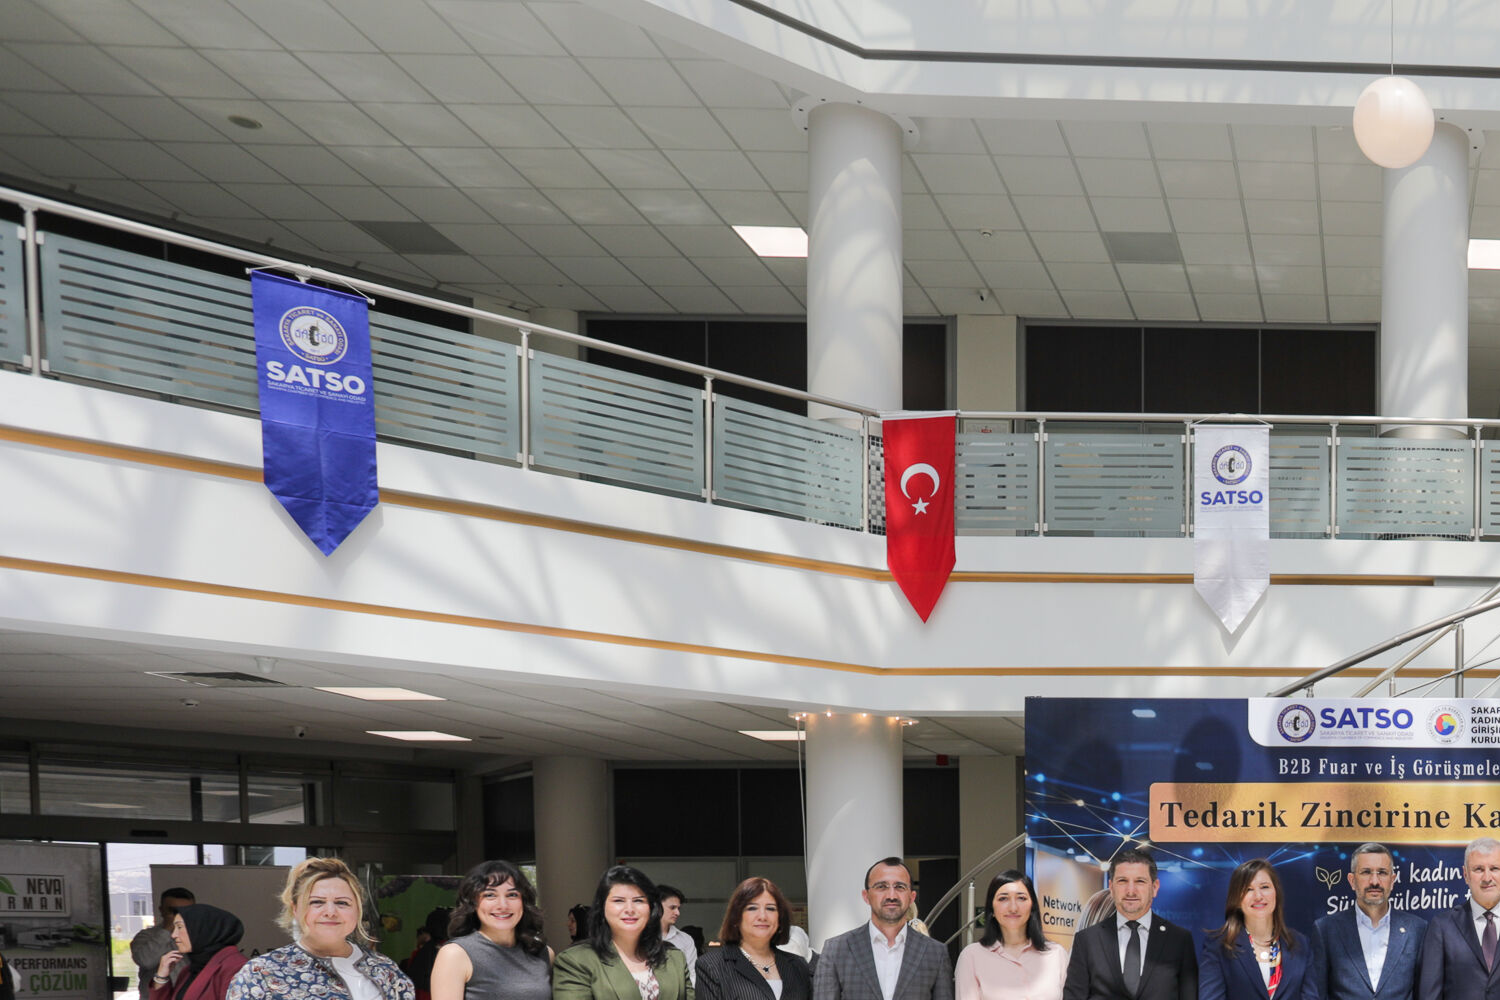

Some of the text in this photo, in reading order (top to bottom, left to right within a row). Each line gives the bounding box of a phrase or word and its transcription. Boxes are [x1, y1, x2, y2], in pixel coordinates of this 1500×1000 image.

[266, 360, 366, 395] SATSO
[1201, 490, 1263, 505] SATSO
[1320, 708, 1413, 729] SATSO
[1279, 758, 1311, 775] B2B
[1318, 758, 1358, 776] Fuar
[1365, 762, 1383, 776] ve
[1390, 755, 1405, 780] İş
[1160, 801, 1288, 828] Tedarik
[1300, 801, 1451, 828] Zincirine
[1409, 860, 1463, 883] kadın
[27, 878, 62, 895] NEVA
[0, 896, 63, 910] RMAN
[1043, 895, 1082, 912] Network
[1327, 887, 1459, 916] Sürülebilir
[1042, 912, 1075, 927] Corner
[14, 958, 88, 970] PERFORMANS
[30, 971, 88, 995] ÇÖZÜM
